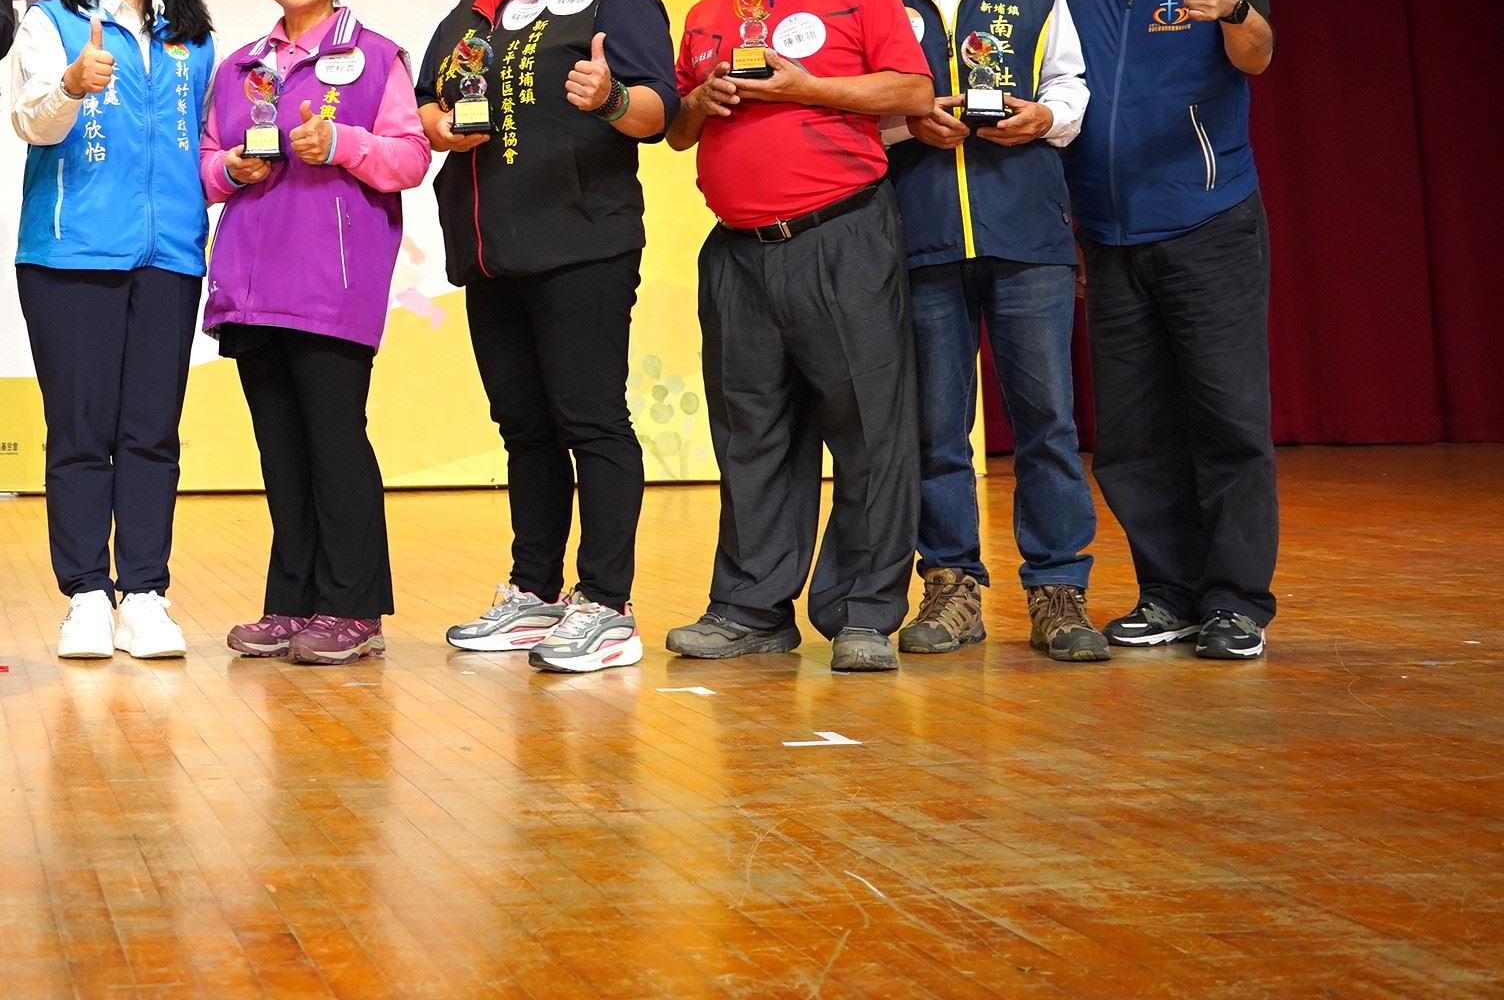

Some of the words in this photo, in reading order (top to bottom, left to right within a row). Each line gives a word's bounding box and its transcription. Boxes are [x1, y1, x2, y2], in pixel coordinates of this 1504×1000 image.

[979, 0, 1020, 17] 新埔鎮
[82, 94, 107, 163] 陳欣怡
[499, 40, 521, 165] 北平社區發展協會
